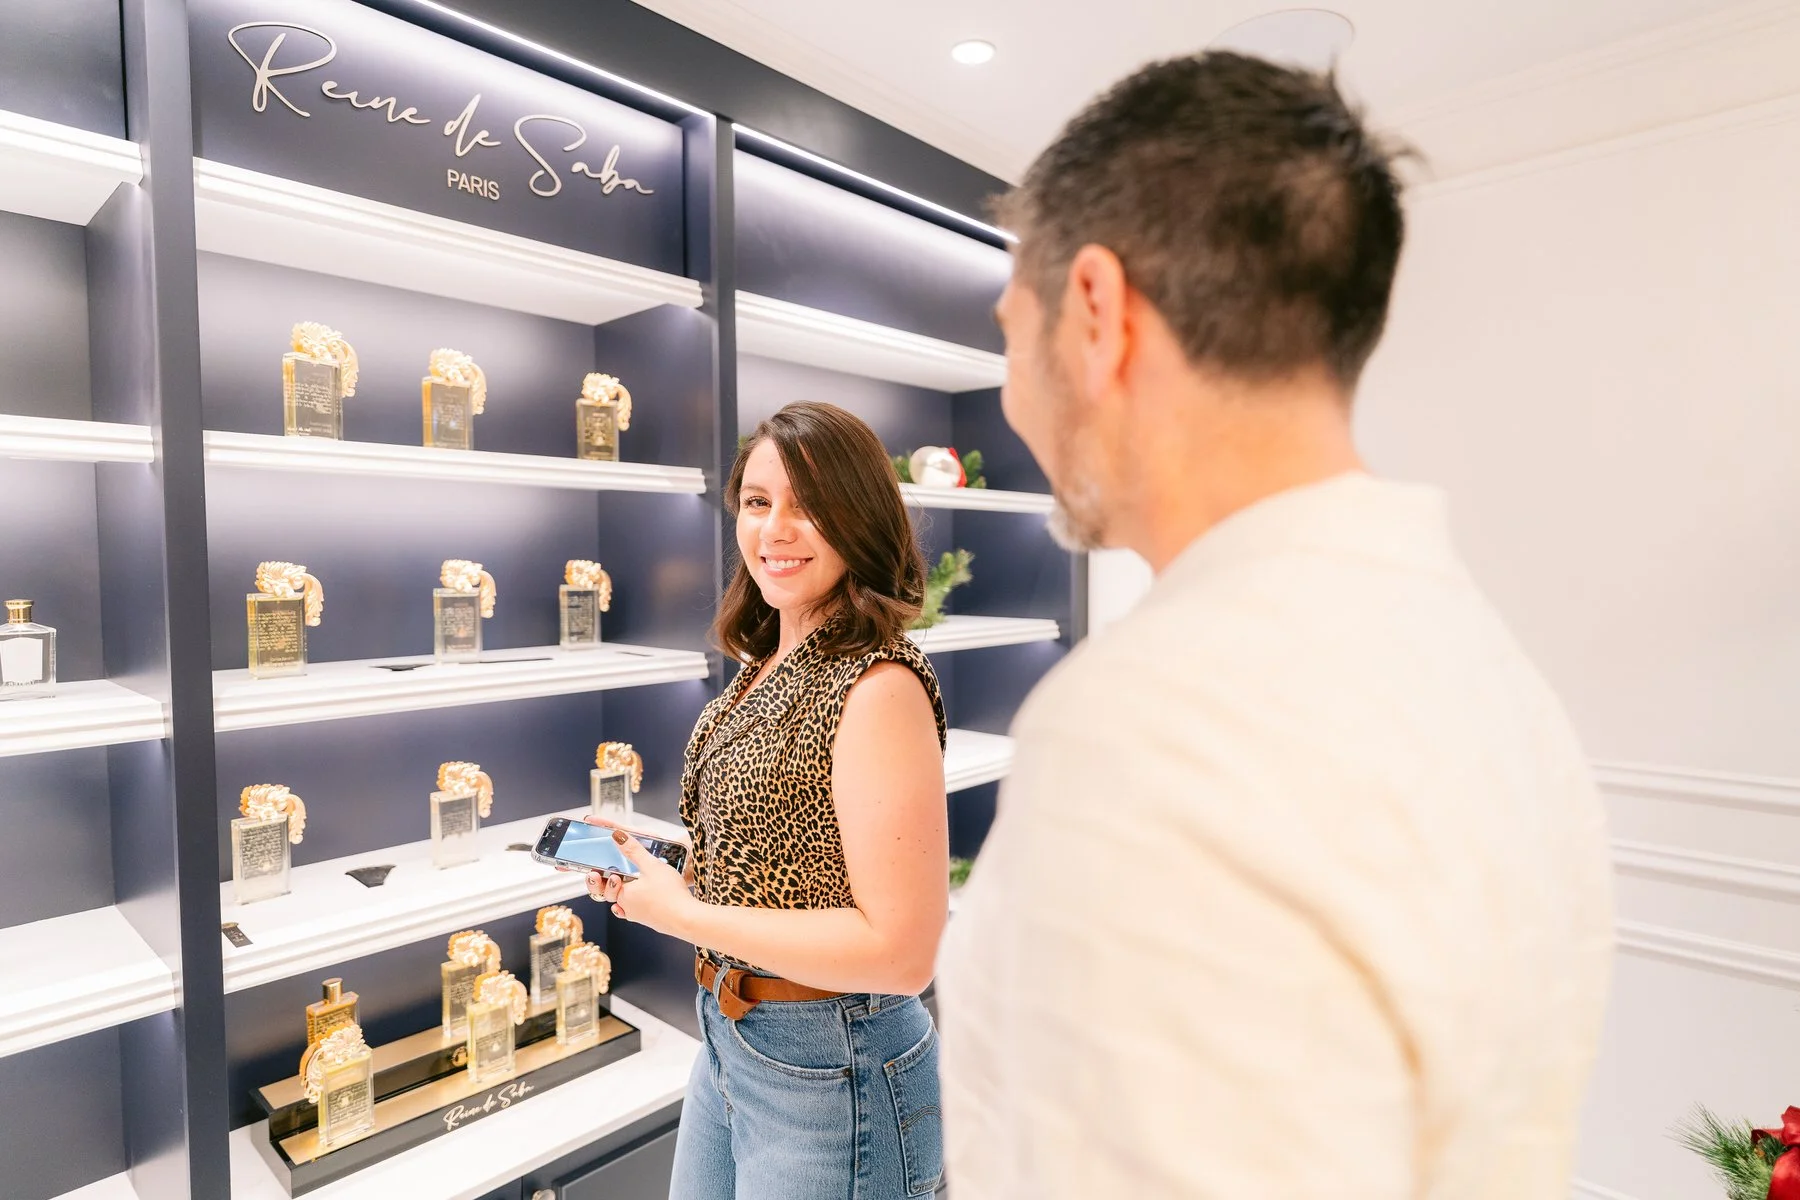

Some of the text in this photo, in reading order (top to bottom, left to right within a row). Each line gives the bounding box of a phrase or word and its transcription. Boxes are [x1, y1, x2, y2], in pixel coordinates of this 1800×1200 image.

[443, 93, 501, 158] de
[513, 113, 655, 197] Saba
[446, 168, 501, 201] PARIS
